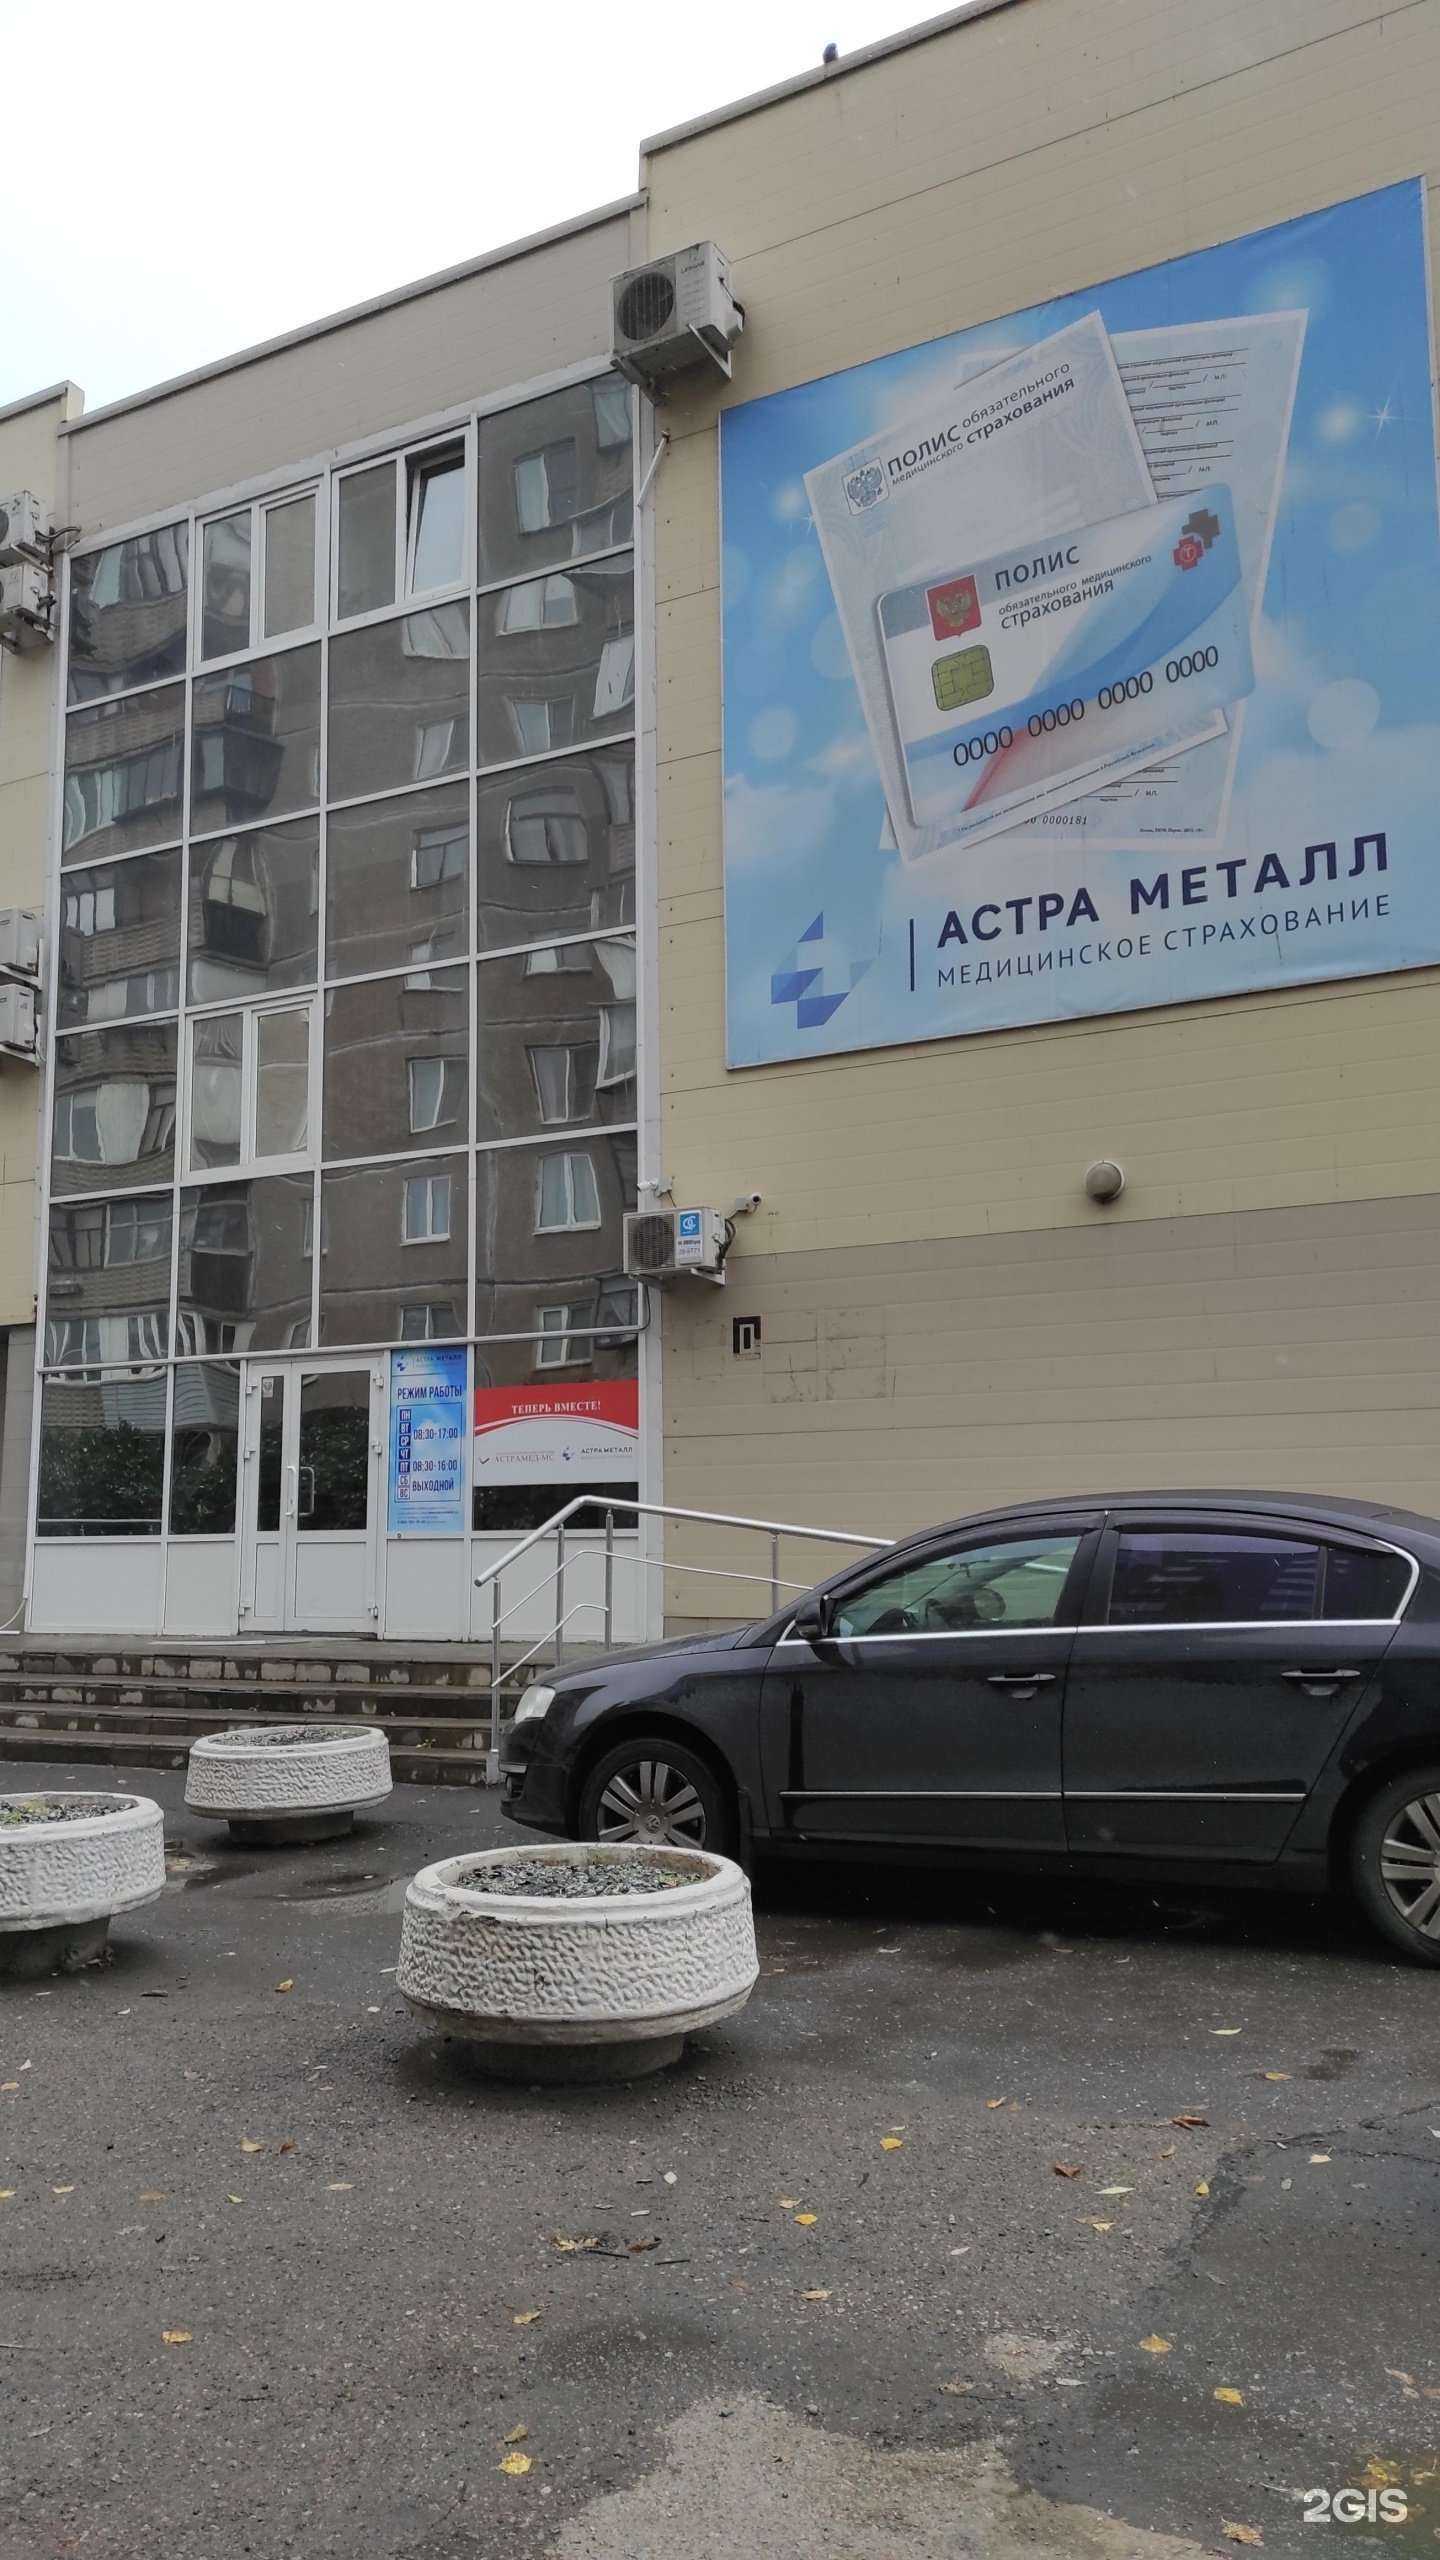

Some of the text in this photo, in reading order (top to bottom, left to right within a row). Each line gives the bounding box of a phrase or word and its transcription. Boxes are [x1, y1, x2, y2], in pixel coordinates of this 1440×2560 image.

[887, 362, 1071, 476] ПОЛИС обязательного
[892, 378, 1075, 486] медицинского страхования
[994, 545, 1081, 591] ПОЛИС
[998, 554, 1152, 616] обязательного медицинского
[1000, 579, 1115, 630] страхования
[953, 645, 1219, 767] 0000 0000 0000 0000
[1042, 815, 1088, 825] 0000181
[936, 832, 1388, 949] АСТРА МЕТАЛЛ
[937, 894, 1391, 988] МЕДИЦИНСКОЕ СТРАХОВАНИЕ
[397, 1384, 463, 1400] РЕЖИМ РАБОТЫ
[511, 1400, 602, 1415] ТЕПЕРЬ ВМЕСТЕ!
[401, 1410, 411, 1421] ПН
[400, 1423, 410, 1433] ВТ
[413, 1427, 458, 1440] 08:30-17:00
[400, 1436, 409, 1446] СР
[400, 1449, 409, 1459] ЧТ
[603, 1446, 633, 1454] МЕТАЛЛ
[400, 1461, 409, 1472] ПТ
[400, 1475, 409, 1485] СБ
[412, 1477, 455, 1492] ВЫХОДНОЙ
[400, 1488, 409, 1498] ВС
